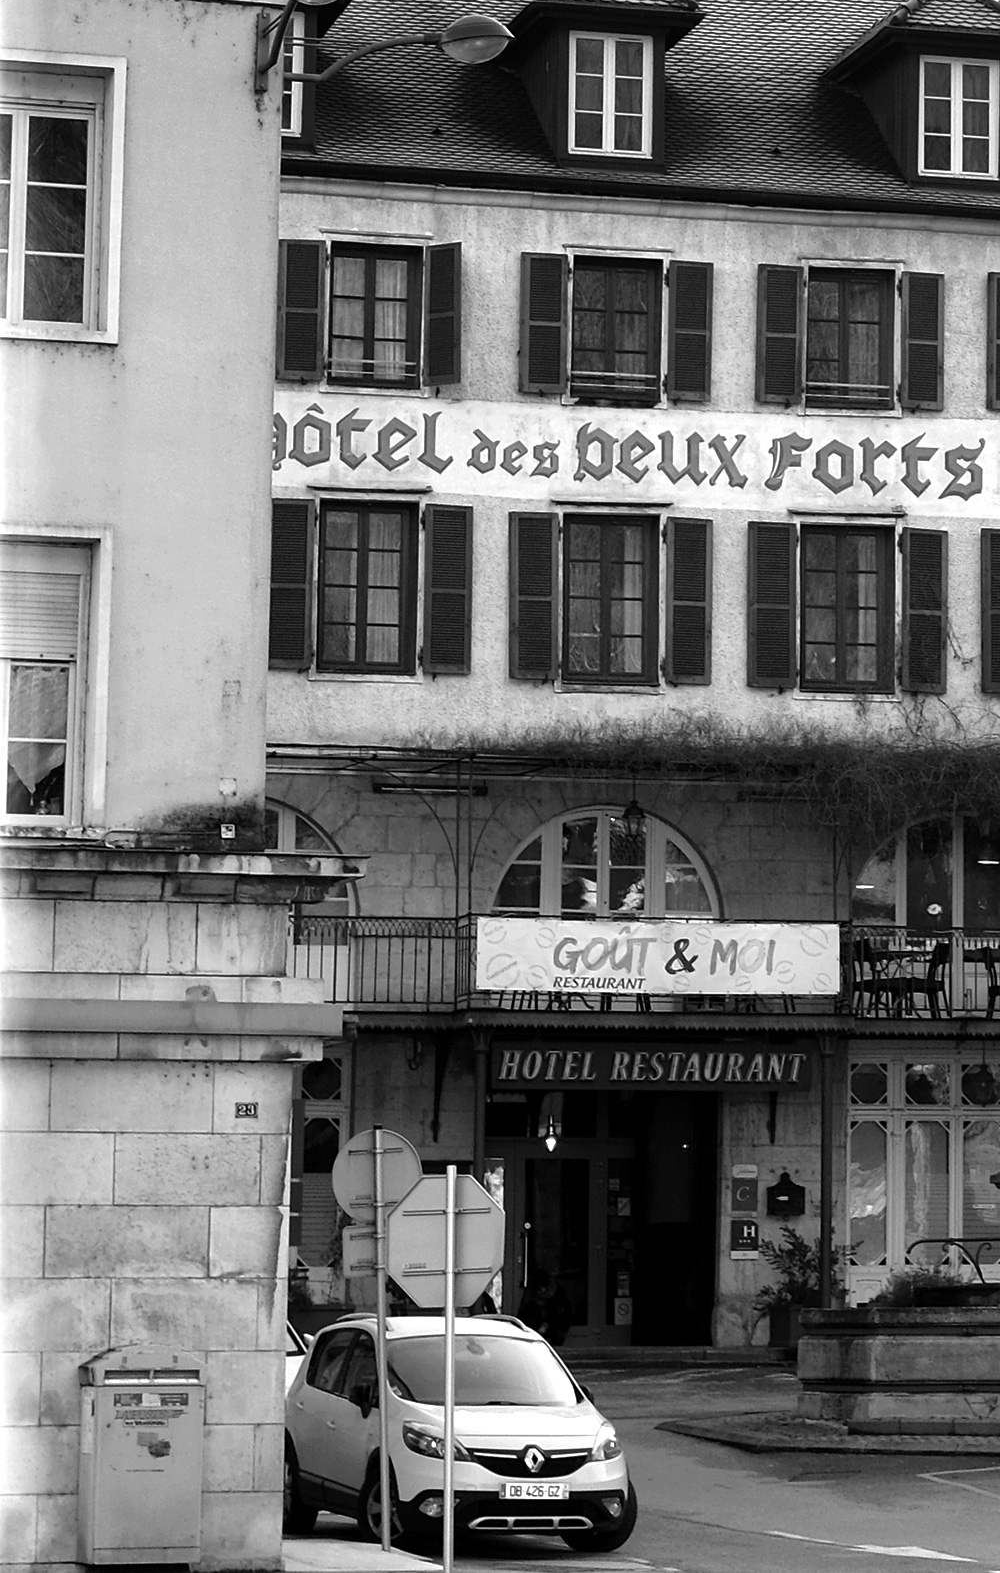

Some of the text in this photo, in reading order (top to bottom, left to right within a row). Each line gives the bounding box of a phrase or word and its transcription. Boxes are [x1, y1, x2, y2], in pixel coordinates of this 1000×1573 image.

[466, 428, 561, 478] des
[573, 421, 749, 491] Deux
[764, 431, 986, 501] Forts
[552, 926, 776, 976] GOÛT & MOI
[552, 976, 647, 990] RESTAURANT
[498, 1049, 807, 1084] HOTEL RESTAURANT
[238, 1104, 255, 1115] 23
[743, 1225, 756, 1237] H
